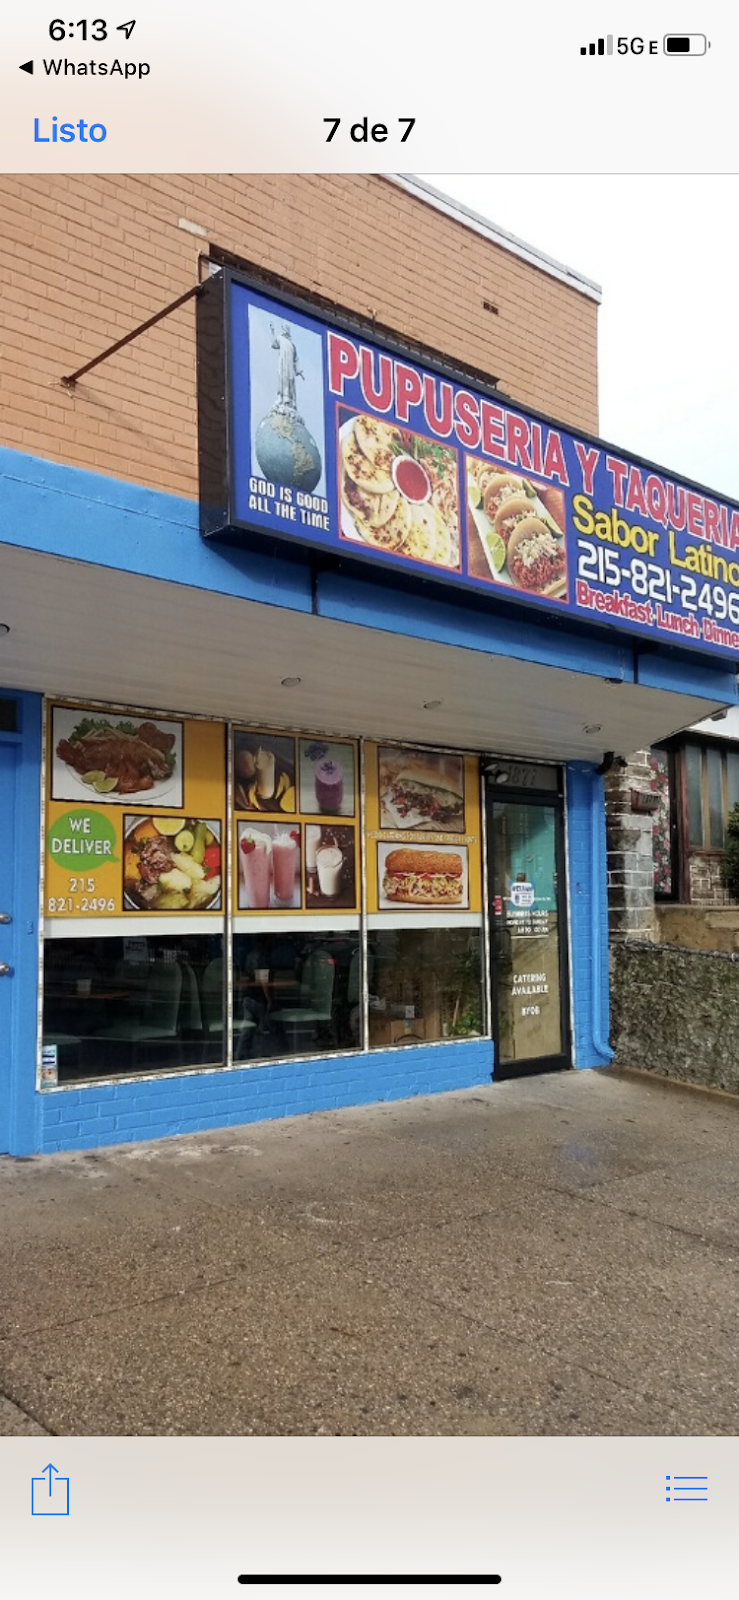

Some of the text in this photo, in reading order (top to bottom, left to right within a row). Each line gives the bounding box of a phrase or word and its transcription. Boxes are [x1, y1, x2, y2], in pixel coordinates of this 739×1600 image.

[326, 330, 570, 487] PUPUSERIA
[573, 440, 600, 495] Y
[249, 476, 328, 514] GOD IS GOOD
[248, 494, 330, 531] ALL THE TIME
[572, 494, 660, 558] Sabor
[577, 538, 739, 625] 215-821-2496
[69, 817, 91, 834] WE
[51, 838, 112, 855] DELIVER
[69, 878, 96, 893] 215
[511, 984, 549, 996] AVAILABLE
[513, 973, 547, 984] CATERING
